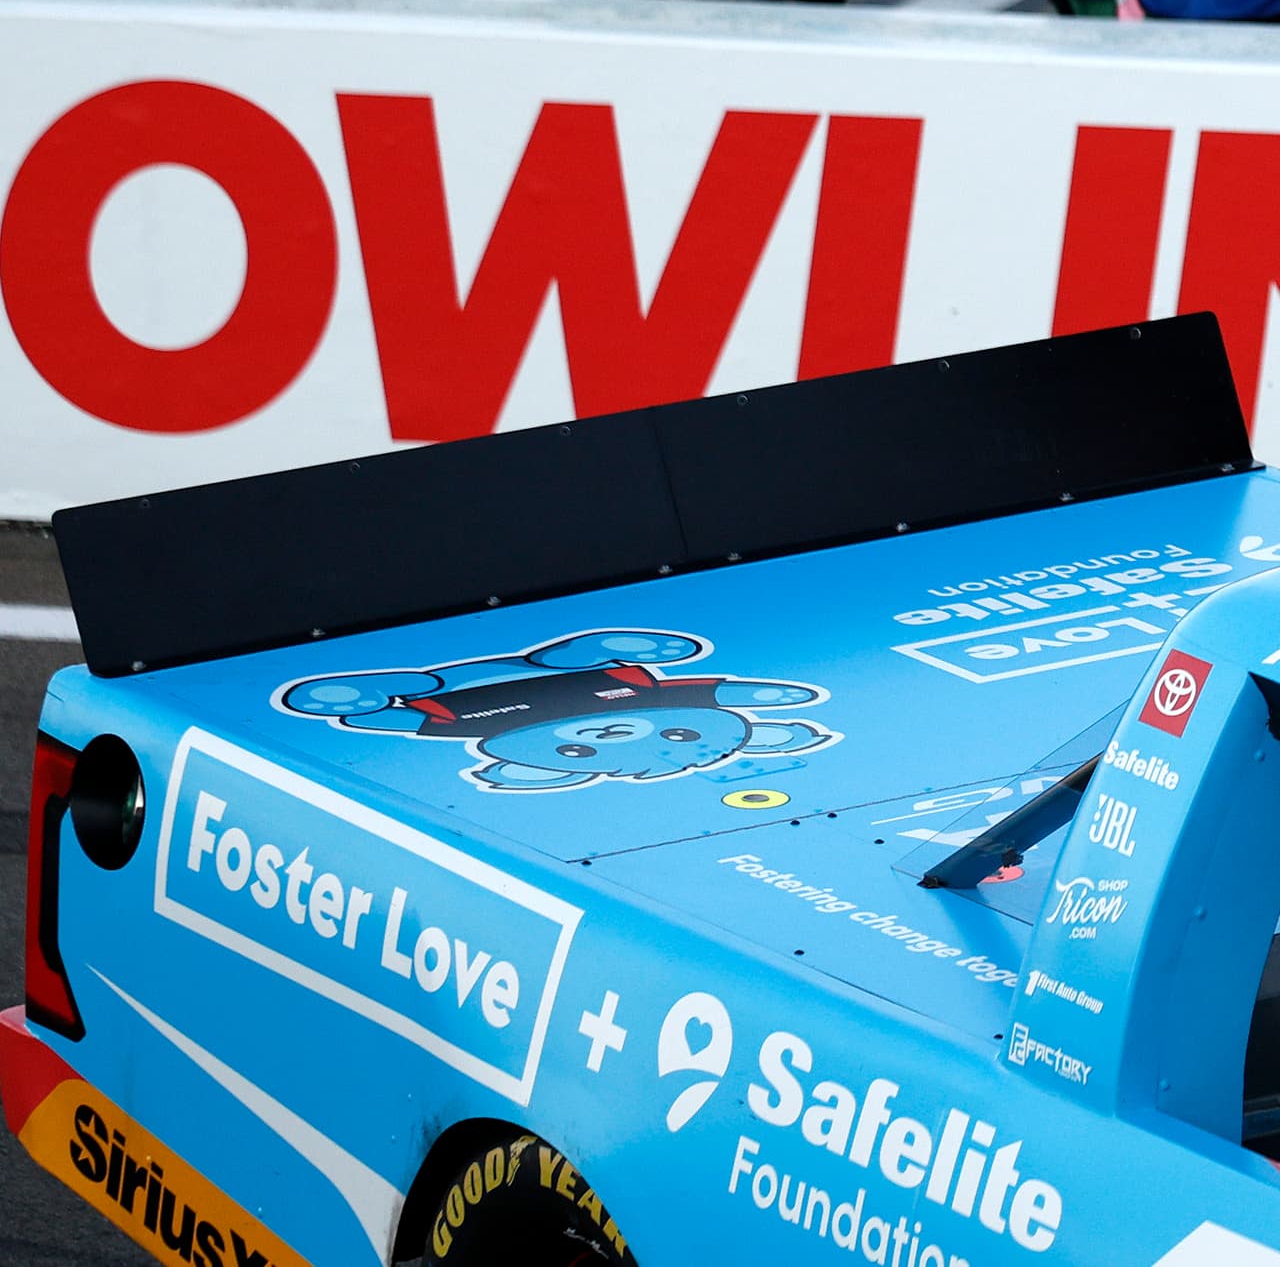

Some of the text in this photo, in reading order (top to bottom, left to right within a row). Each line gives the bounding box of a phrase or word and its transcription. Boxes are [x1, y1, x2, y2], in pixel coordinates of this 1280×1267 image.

[892, 557, 1234, 626] Safelite
[927, 544, 1193, 599] Foundation
[963, 616, 1170, 661] Love
[1103, 740, 1181, 792] Safelite
[187, 789, 373, 951] Foster
[380, 886, 521, 1029] Love
[717, 853, 857, 914] Fostering
[849, 908, 963, 960] change
[1046, 878, 1129, 925] Tricon
[1098, 879, 1129, 892] SHOP
[747, 1030, 1064, 1253] Safelite
